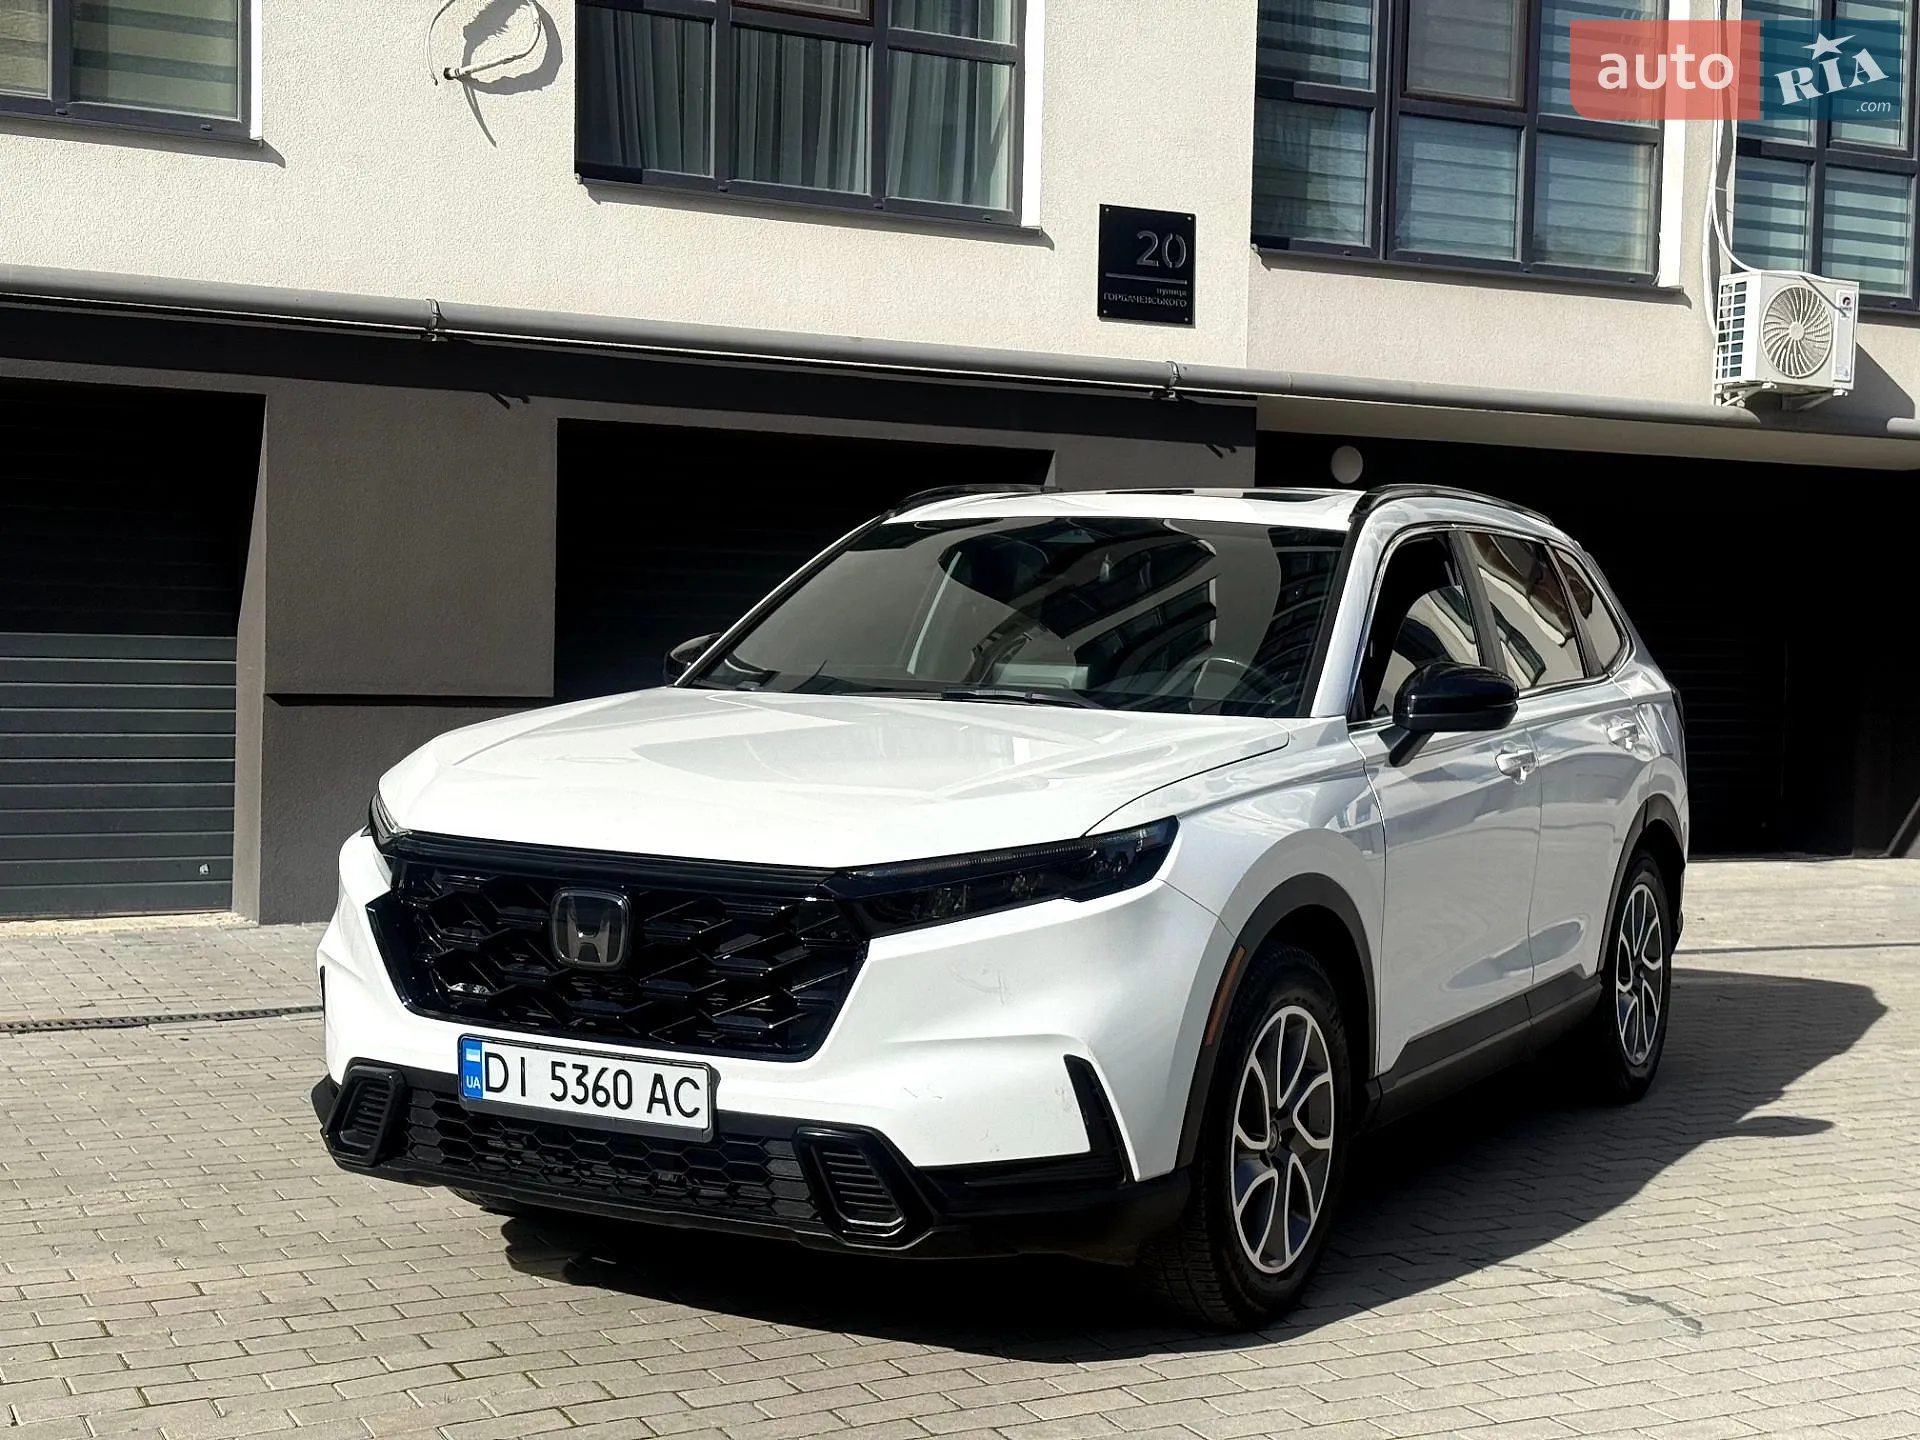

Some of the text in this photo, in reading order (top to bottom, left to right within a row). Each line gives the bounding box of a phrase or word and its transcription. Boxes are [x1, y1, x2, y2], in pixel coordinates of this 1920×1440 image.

[1136, 230, 1187, 268] 20
[466, 1075, 481, 1090] UA
[485, 1052, 700, 1118] DI 5360 AC
